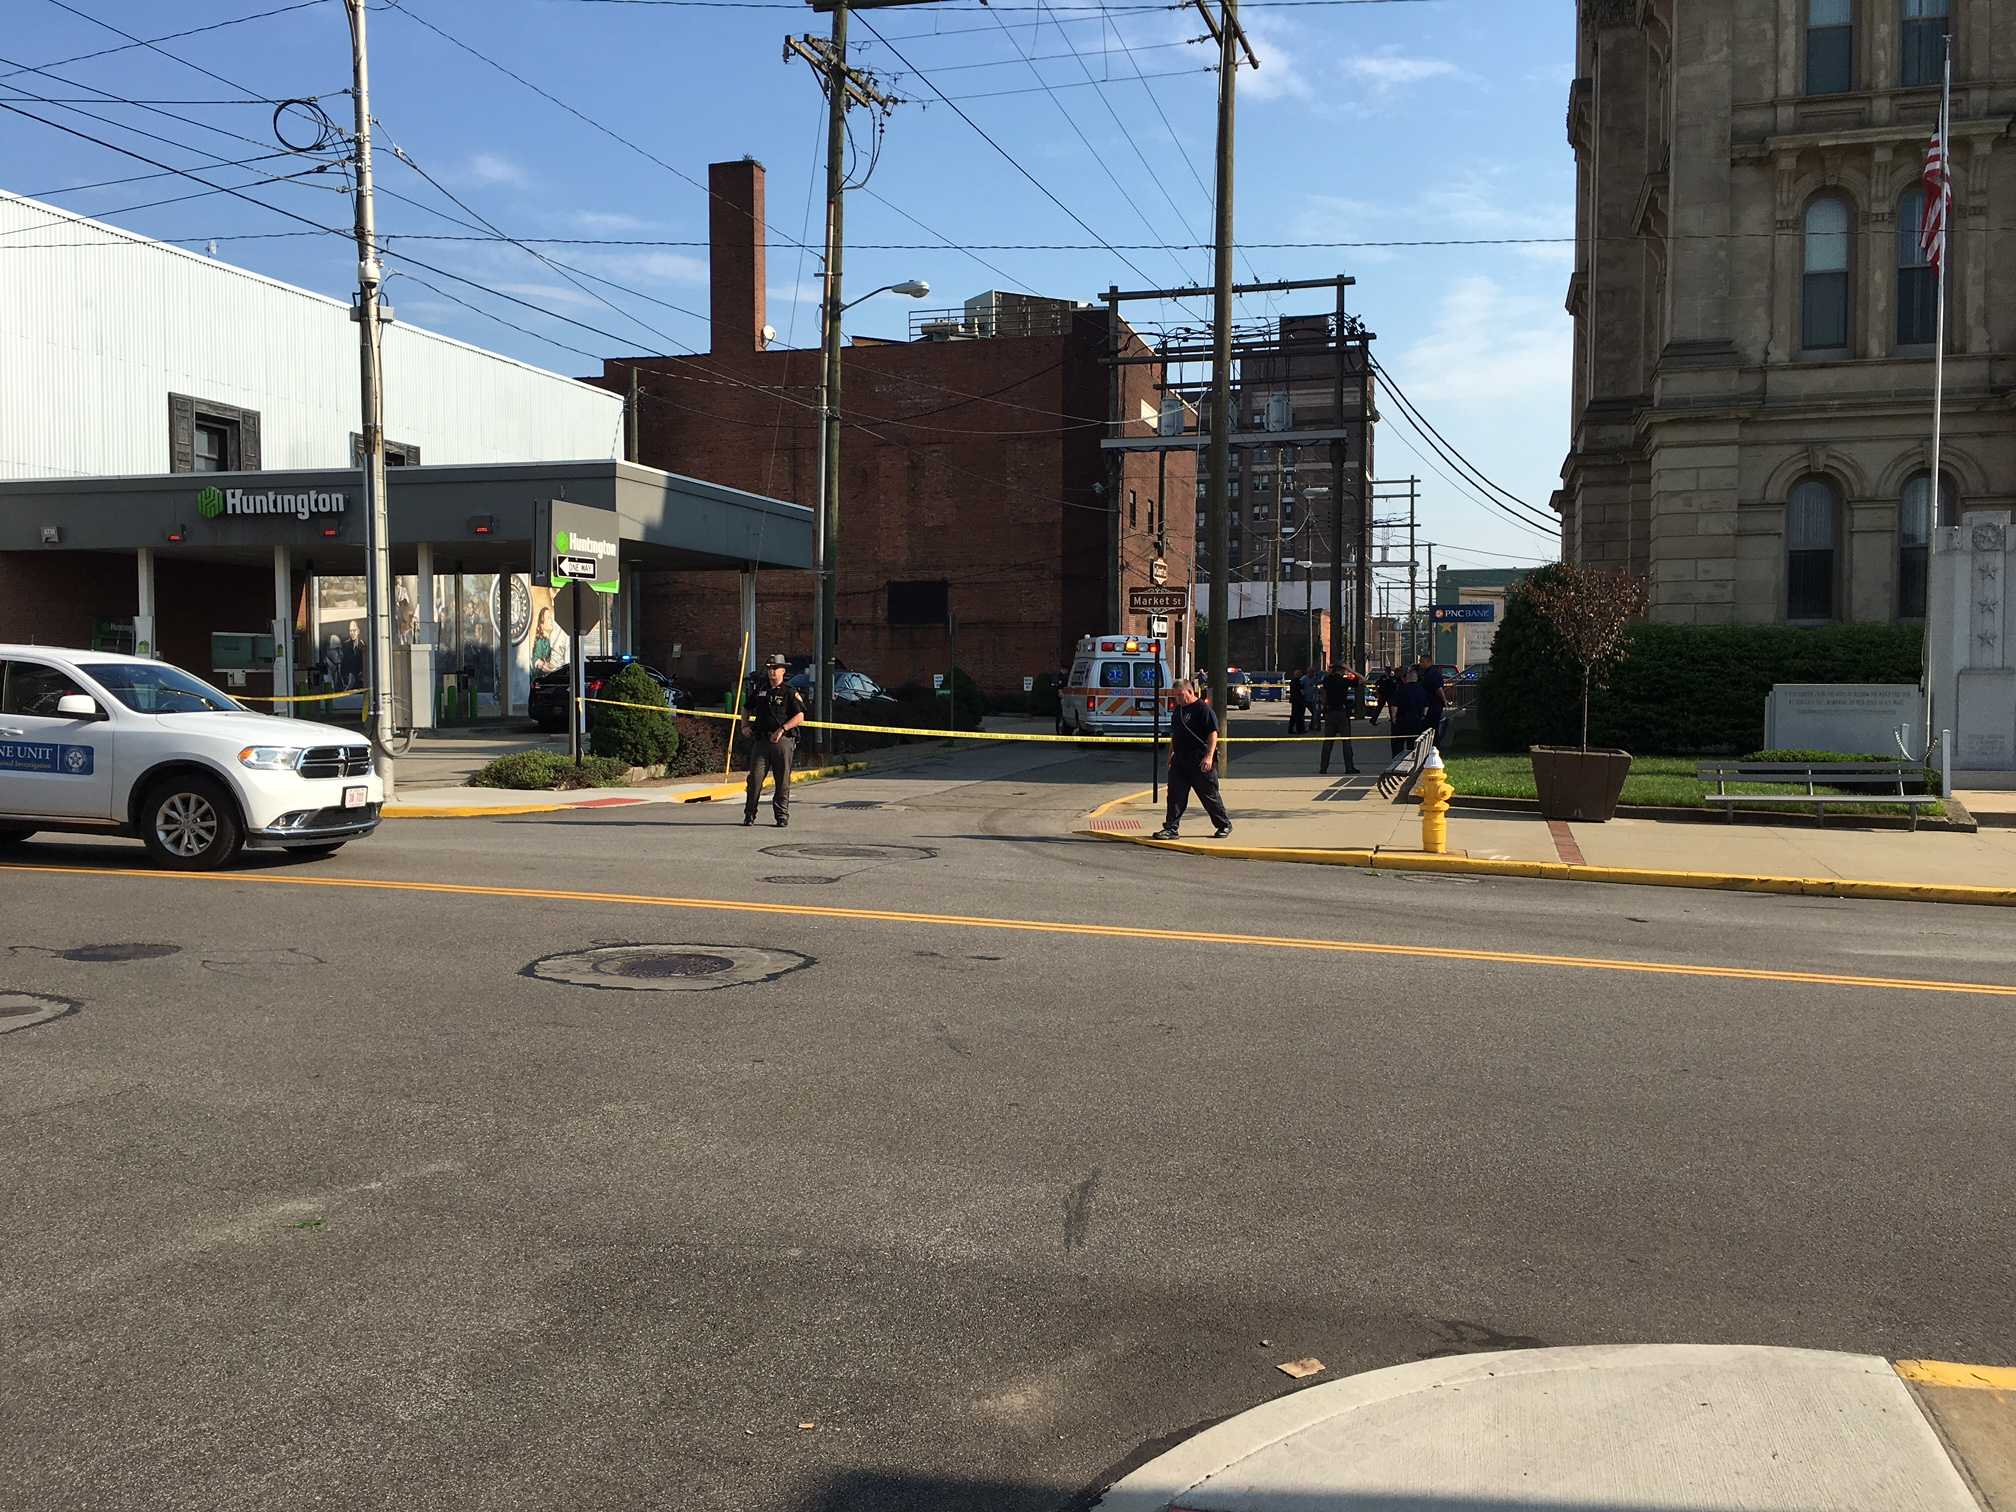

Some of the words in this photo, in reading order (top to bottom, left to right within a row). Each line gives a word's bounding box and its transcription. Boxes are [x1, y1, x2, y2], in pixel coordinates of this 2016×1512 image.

[226, 489, 344, 519] Huntington
[569, 532, 616, 559] Huntington
[568, 563, 579, 571] ONE
[1133, 596, 1170, 606] Market
[1172, 597, 1181, 605] St
[17, 746, 53, 760] UNIT
